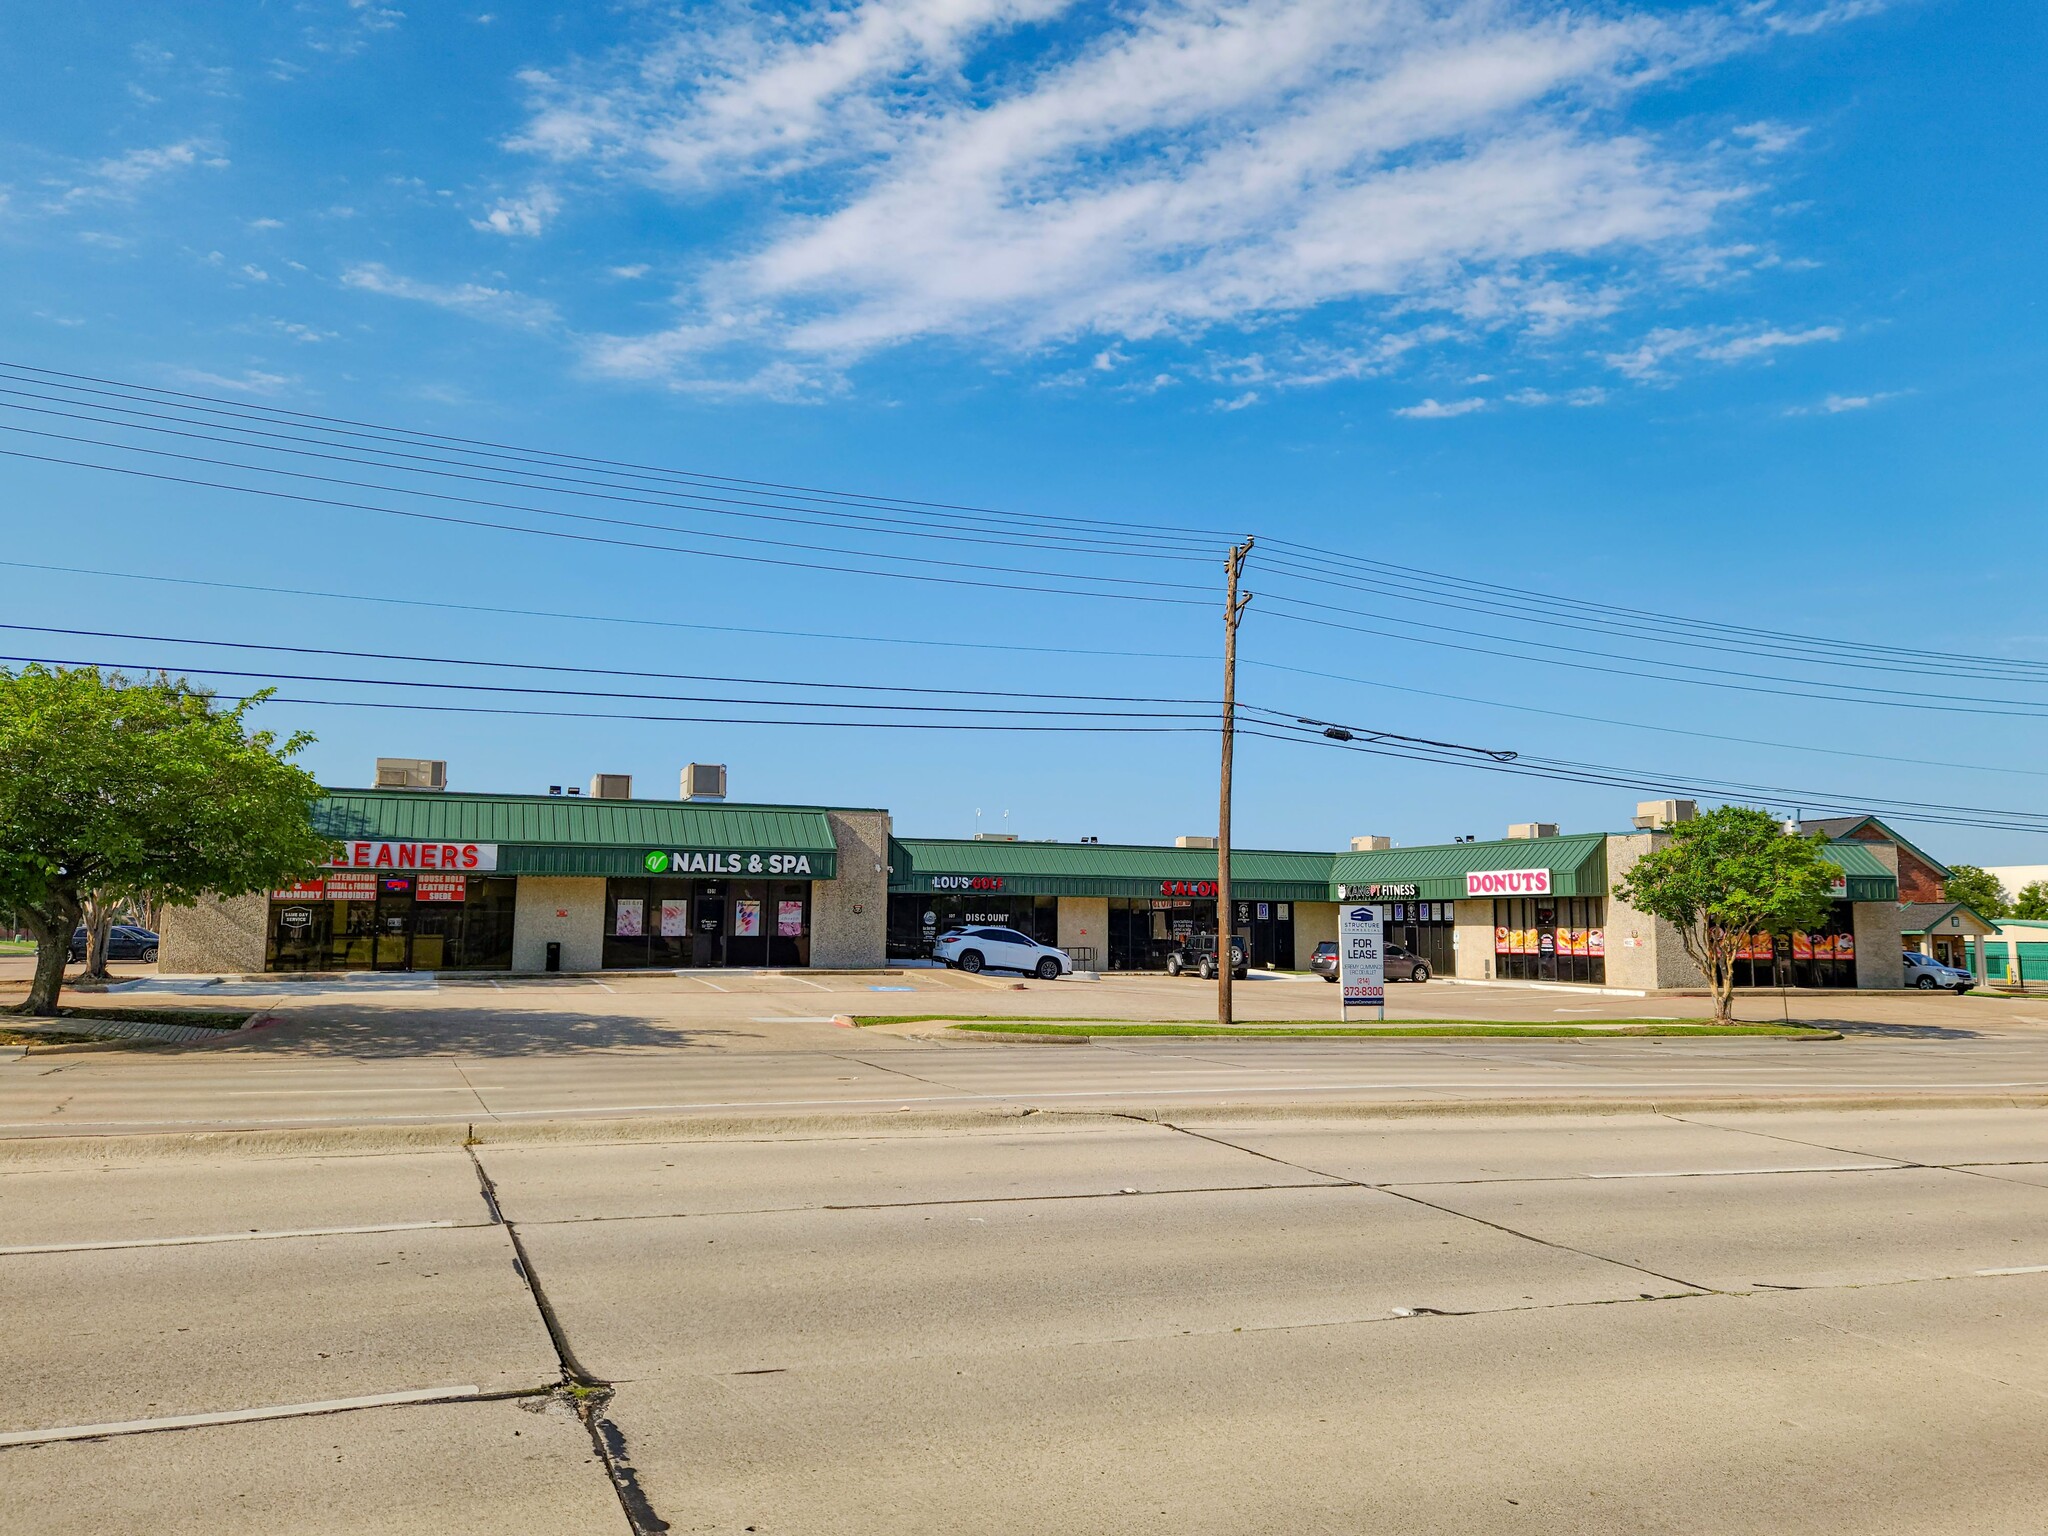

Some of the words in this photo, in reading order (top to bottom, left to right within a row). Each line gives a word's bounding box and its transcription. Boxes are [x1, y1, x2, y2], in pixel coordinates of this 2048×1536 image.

[672, 852, 742, 873] NAILS
[747, 854, 763, 873] &
[768, 855, 811, 874] SPA
[419, 875, 443, 883] HOUSE
[446, 875, 465, 883] HOLD
[933, 876, 969, 889] LOU'S
[971, 877, 1003, 889] GOLF
[1469, 872, 1548, 893] DONUTS
[354, 882, 376, 890] FORMAL
[386, 881, 408, 889] OPEN
[1382, 884, 1415, 896] FITNESS
[327, 891, 375, 899] EMBROIDERY
[429, 892, 452, 900] SUEDE
[966, 914, 986, 922] DISC
[988, 914, 1010, 922] OUNT
[1353, 938, 1372, 948] FOR
[1348, 950, 1377, 959] LEASE
[1344, 986, 1384, 996] 373-8300
